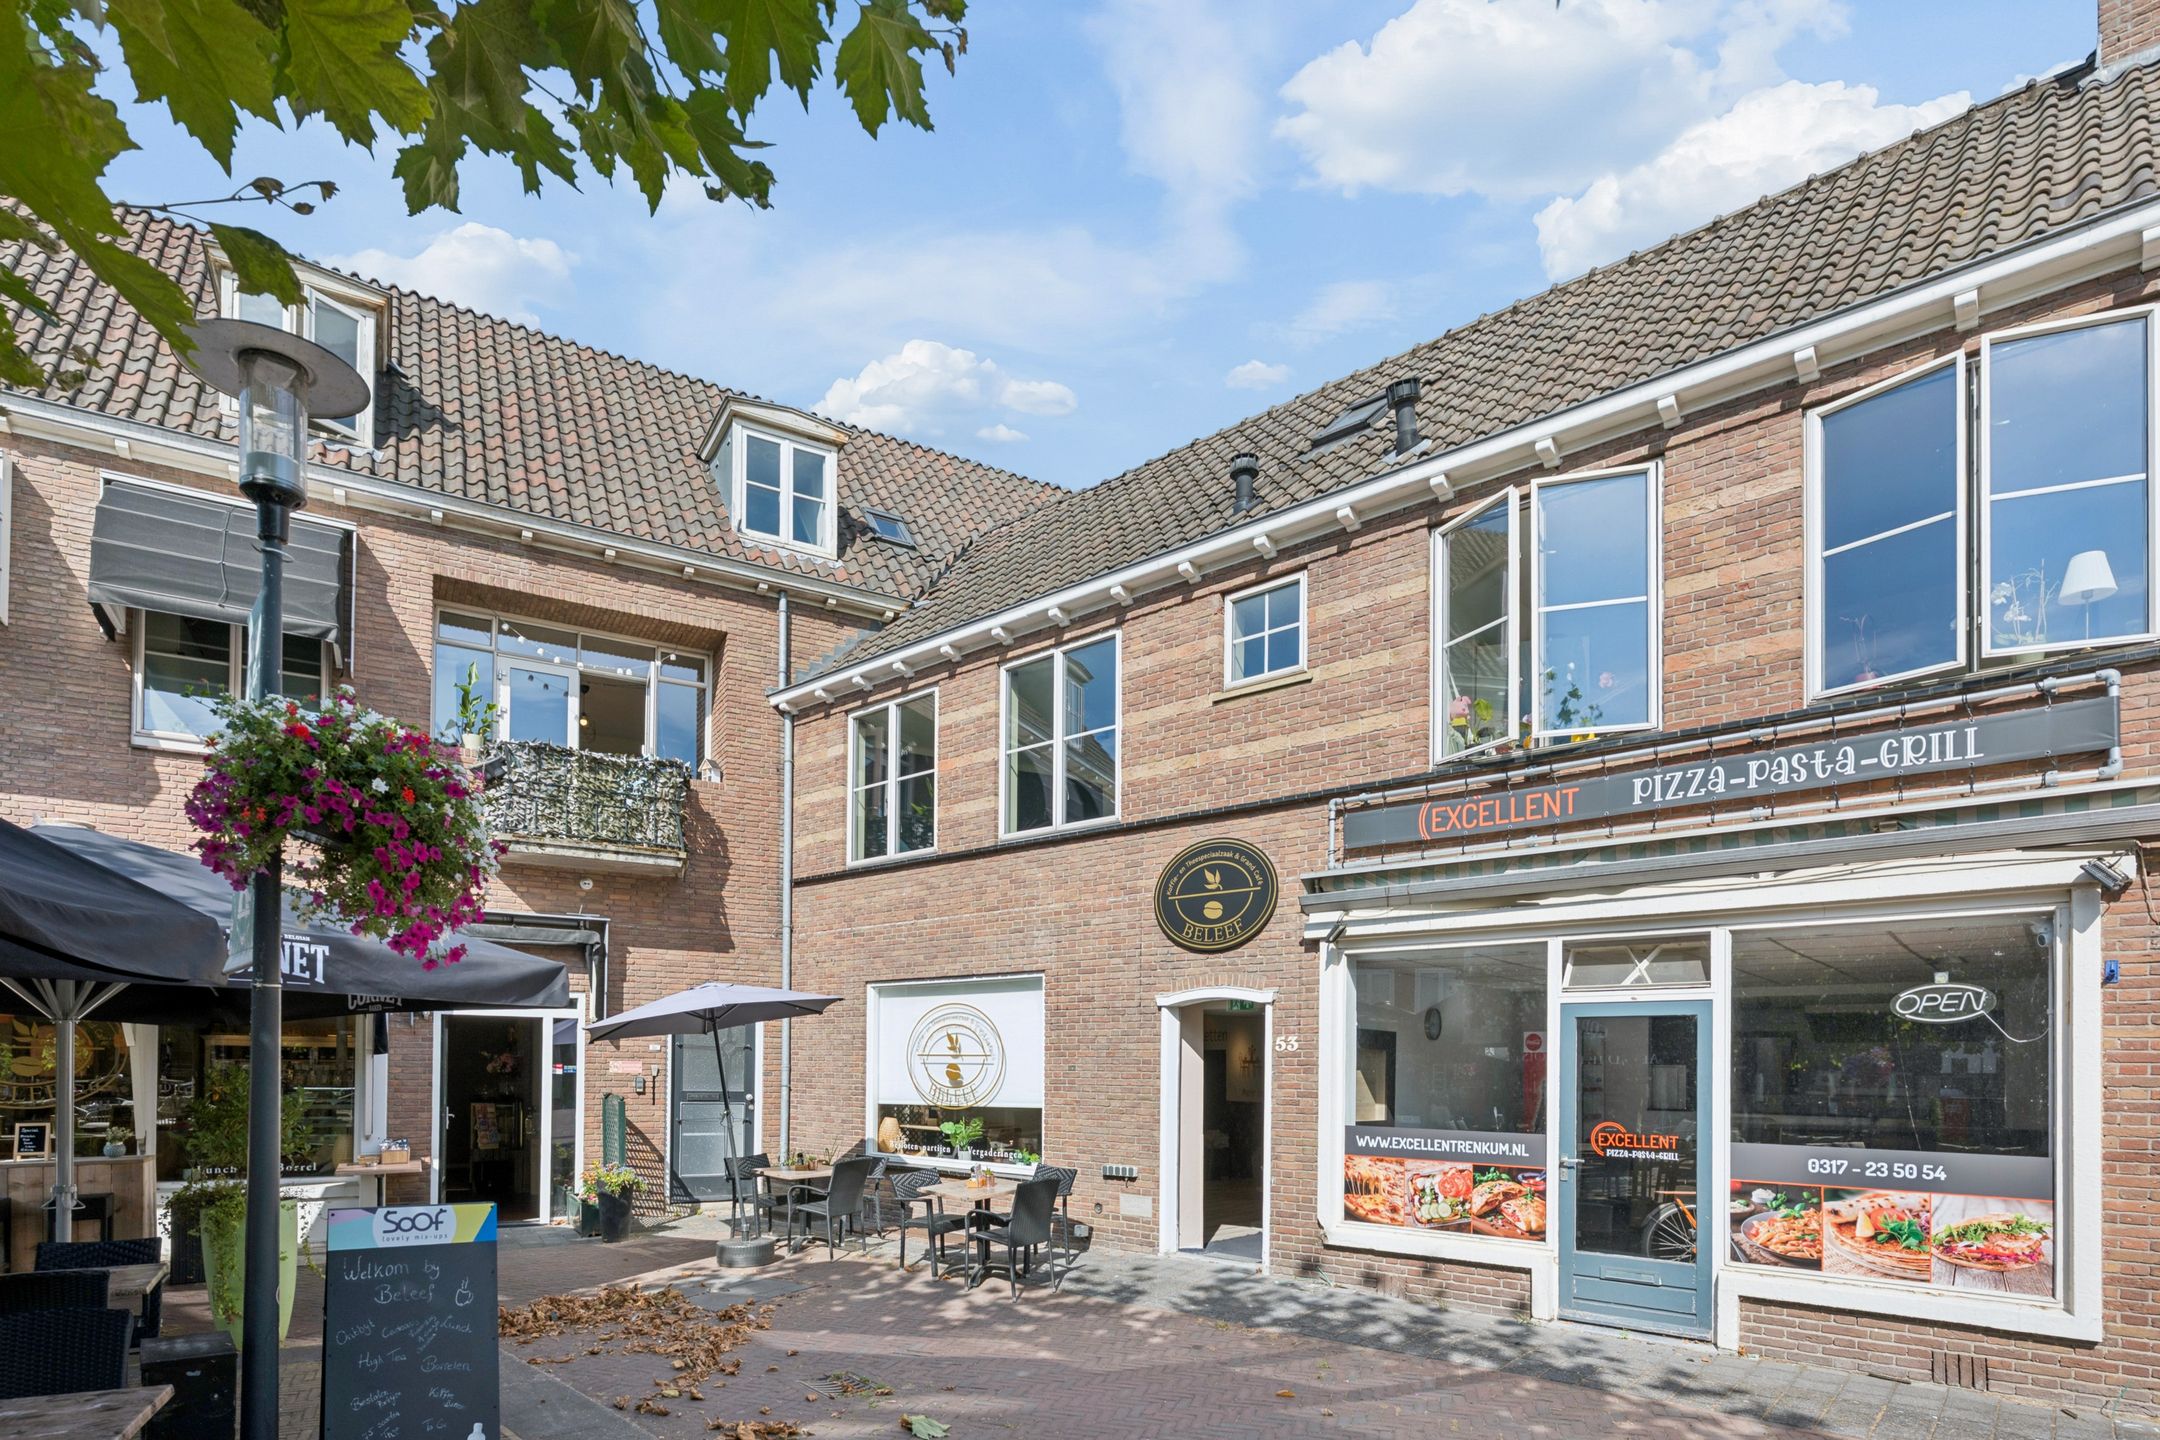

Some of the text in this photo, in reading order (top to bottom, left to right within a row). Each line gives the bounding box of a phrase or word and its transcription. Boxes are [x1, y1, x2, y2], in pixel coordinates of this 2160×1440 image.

[1431, 787, 1580, 833] EXCELLENT
[1240, 855, 1256, 872] Grand
[1182, 918, 1244, 942] BELEEF
[1896, 991, 1986, 1014] OPEN
[1275, 1036, 1299, 1051] 53
[1356, 1135, 1529, 1157] WWW.EXCELLENTRENKUM.NL
[1598, 1132, 1680, 1149] EXCELLENT
[967, 1146, 1023, 1161] Vergaderingen
[1807, 1158, 1848, 1174] 0317
[1865, 1161, 1889, 1177] 23
[1892, 1163, 1918, 1179] 50
[1922, 1165, 1947, 1181] 54
[414, 1233, 448, 1241] mix-ups
[343, 1255, 409, 1281] Welkom
[374, 1283, 435, 1304] Beleef
